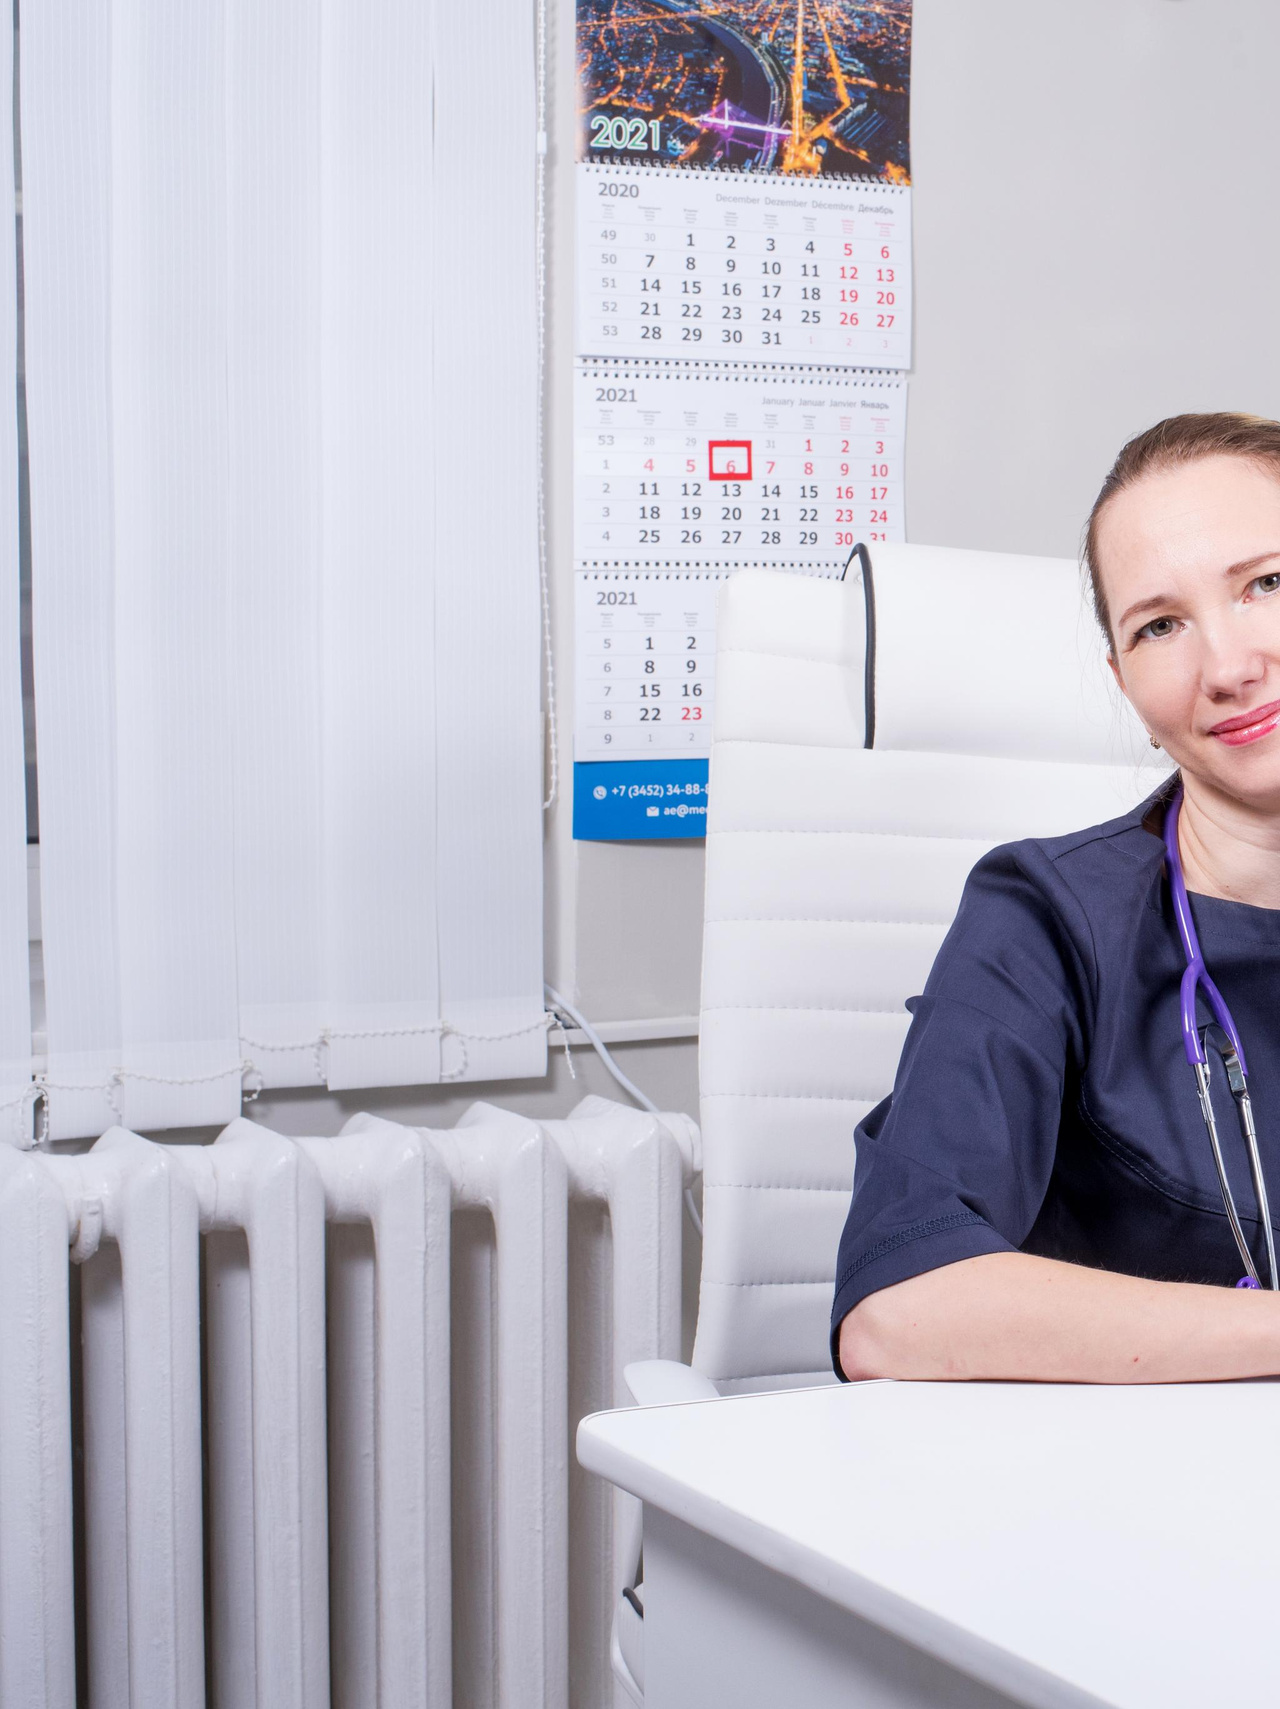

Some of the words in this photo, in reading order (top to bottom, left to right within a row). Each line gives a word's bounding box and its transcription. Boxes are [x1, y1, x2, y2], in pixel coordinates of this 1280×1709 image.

[590, 115, 661, 151] 2021
[598, 182, 640, 199] 2020
[715, 193, 761, 206] December
[764, 196, 808, 209] Dezember
[811, 199, 855, 212] Décembre
[858, 203, 894, 215] Декабрь
[600, 229, 617, 241] 49
[644, 232, 657, 243] 30
[687, 233, 695, 247] 1
[726, 235, 736, 250] 2
[766, 237, 776, 252] 3
[804, 240, 815, 254] 4
[843, 242, 853, 257] 5
[880, 245, 890, 260] 6
[601, 252, 618, 265] 50
[645, 254, 655, 268] 7
[685, 256, 696, 271] 8
[726, 258, 736, 273] 9
[762, 261, 782, 276] 10
[801, 263, 820, 278] 11
[839, 266, 858, 280] 12
[877, 268, 895, 283] 13
[601, 277, 617, 289] 51
[641, 278, 662, 292] 14
[681, 280, 702, 295] 15
[722, 282, 742, 297] 16
[762, 284, 782, 299] 17
[801, 287, 821, 301] 18
[840, 289, 859, 303] 19
[876, 291, 895, 306] 20
[601, 301, 618, 313] 52
[640, 301, 661, 316] 21
[681, 303, 702, 318] 22
[721, 305, 742, 320] 23
[761, 307, 783, 322] 24
[801, 309, 821, 324] 25
[839, 311, 859, 326] 26
[876, 313, 895, 328] 27
[602, 325, 619, 337] 53
[640, 325, 662, 340] 28
[681, 327, 703, 342] 29
[721, 329, 743, 344] 30
[761, 331, 782, 346] 31
[845, 337, 853, 348] 2
[595, 387, 638, 403] 2021
[761, 396, 795, 408] January
[798, 397, 826, 408] Januar
[829, 399, 857, 409] Janvier
[860, 400, 890, 411] Январь
[597, 434, 615, 446] 53
[643, 435, 656, 446] 28
[685, 436, 698, 447] 29
[805, 438, 813, 452] 1
[841, 439, 850, 454] 2
[875, 440, 884, 455] 3
[602, 459, 610, 470] 1
[643, 458, 655, 472] 4
[686, 458, 696, 473] 5
[726, 459, 736, 474] 6
[766, 460, 776, 475] 7
[803, 461, 814, 476] 8
[840, 462, 850, 477] 9
[871, 463, 889, 478] 10
[602, 482, 611, 494] 2
[639, 482, 660, 496] 11
[681, 482, 702, 497] 12
[722, 483, 742, 498] 13
[762, 484, 781, 498] 14
[800, 485, 819, 499] 15
[836, 486, 854, 500] 16
[871, 486, 888, 500] 17
[601, 506, 611, 518] 3
[639, 505, 661, 520] 18
[681, 506, 702, 520] 19
[721, 506, 742, 521] 20
[761, 507, 781, 521] 21
[799, 508, 818, 522] 22
[835, 508, 854, 523] 23
[870, 509, 888, 523] 24
[601, 530, 611, 542] 4
[638, 529, 661, 544] 25
[680, 529, 702, 544] 26
[721, 530, 742, 544] 27
[761, 530, 781, 545] 28
[799, 531, 818, 545] 29
[835, 531, 854, 546] 30
[596, 591, 638, 607] 2021
[603, 638, 612, 650] 5
[645, 636, 654, 651] 1
[686, 636, 697, 650] 2
[603, 662, 612, 673] 6
[644, 660, 655, 674] 8
[686, 659, 697, 674] 9
[603, 685, 612, 697] 7
[640, 683, 661, 698] 15
[682, 683, 703, 697] 16
[603, 709, 613, 721] 8
[639, 707, 661, 722] 22
[681, 706, 703, 721] 23
[603, 733, 613, 745] 9
[611, 785, 626, 797] +7
[628, 784, 664, 798] (3452)
